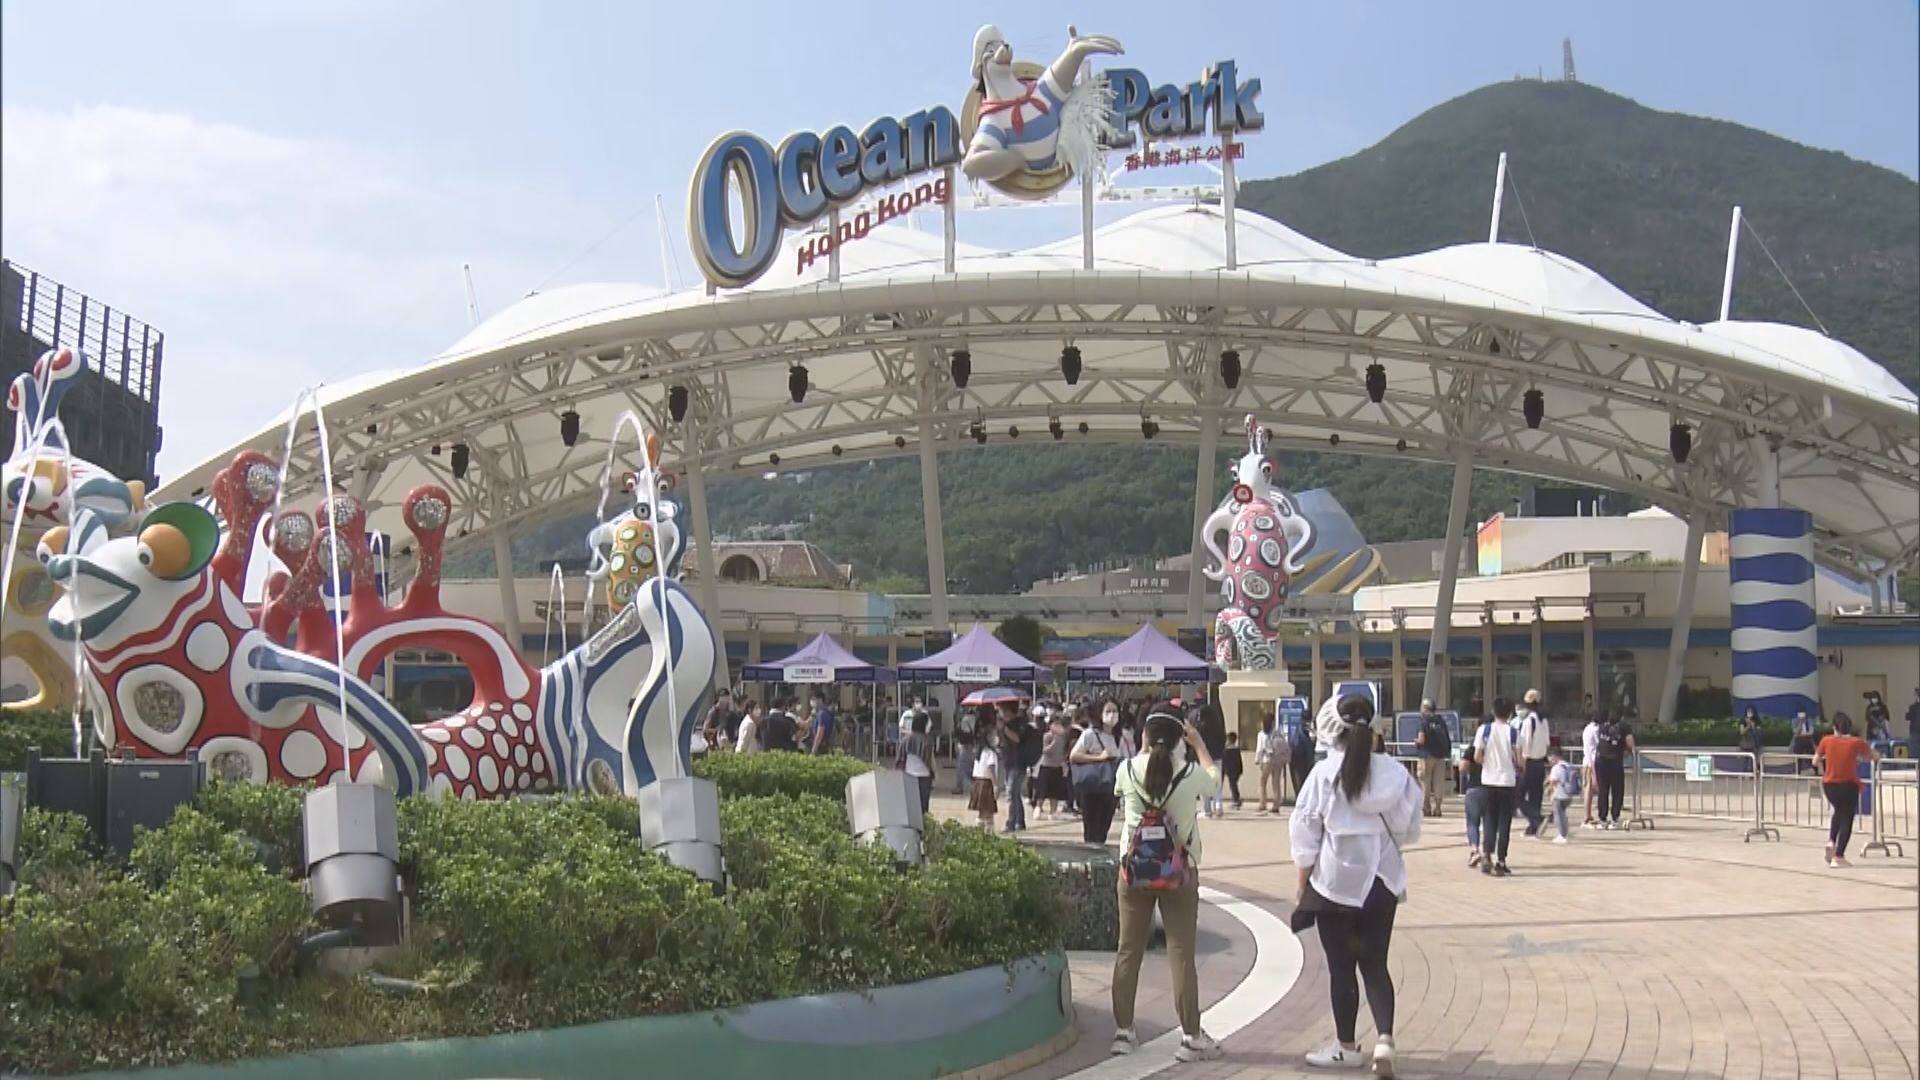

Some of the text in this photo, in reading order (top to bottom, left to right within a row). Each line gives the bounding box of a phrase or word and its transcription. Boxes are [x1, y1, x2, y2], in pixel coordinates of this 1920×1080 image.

[687, 60, 1264, 288] Ocean Park
[797, 177, 950, 276] Hong Kong
